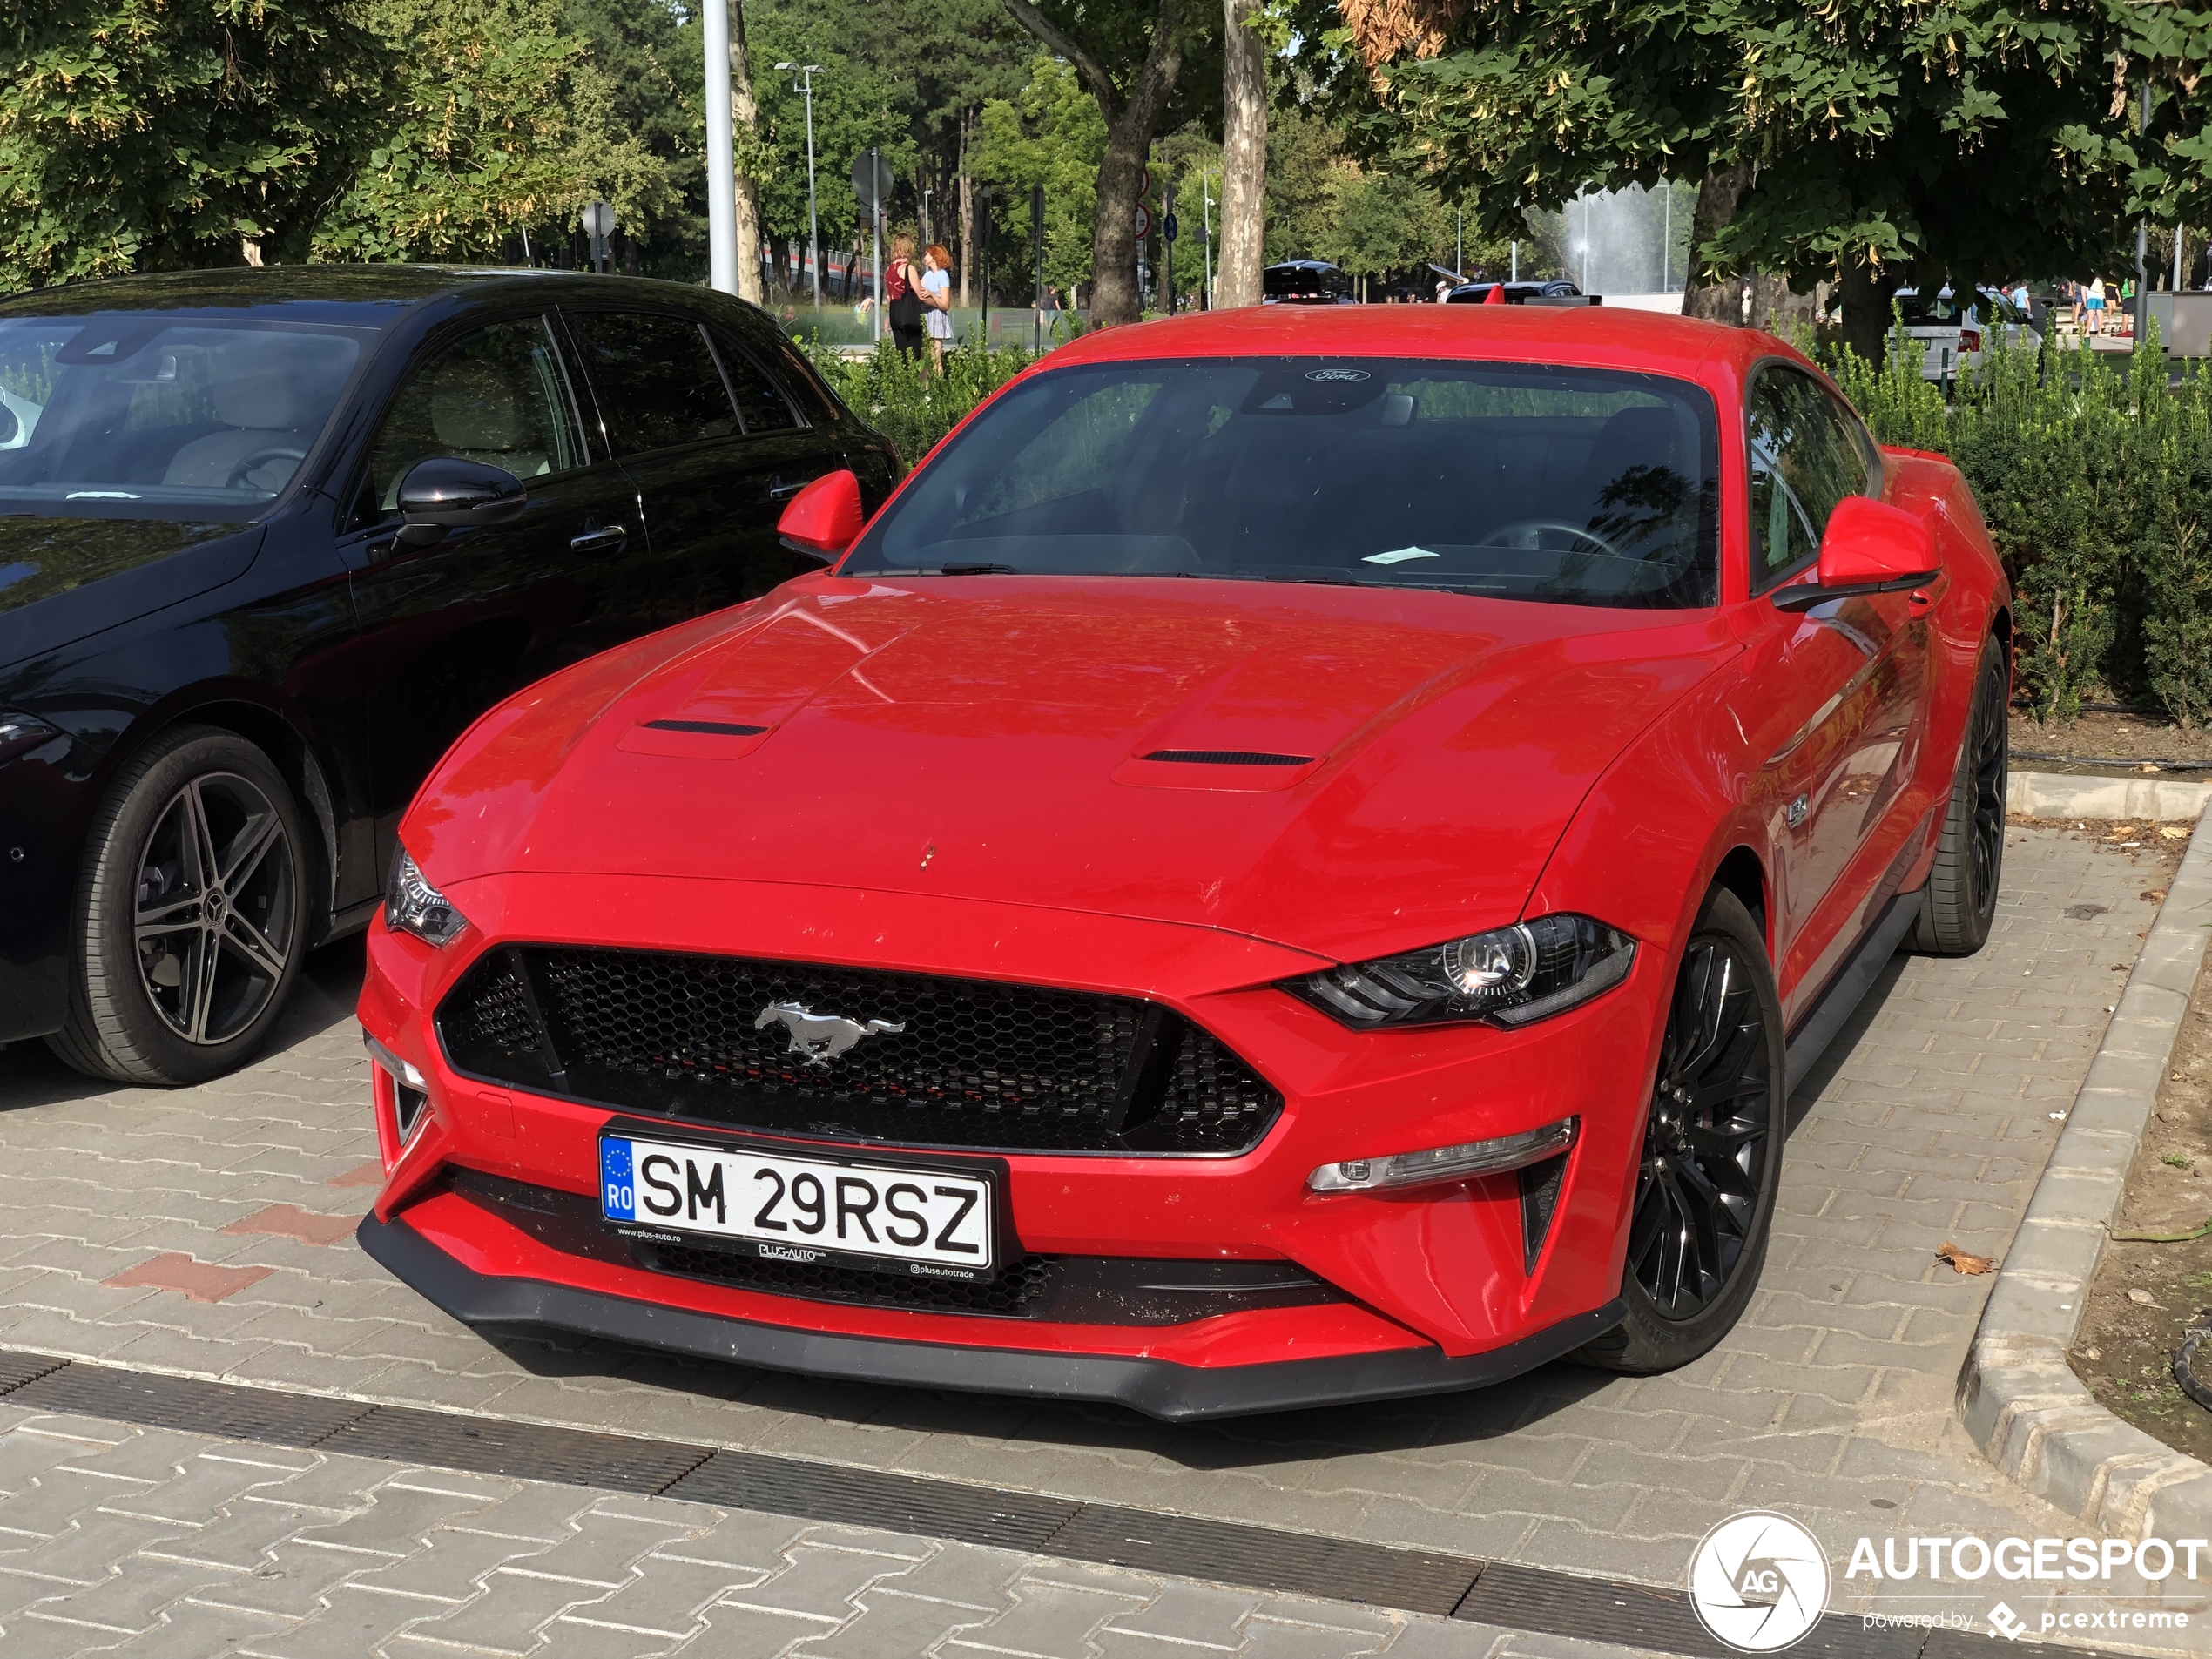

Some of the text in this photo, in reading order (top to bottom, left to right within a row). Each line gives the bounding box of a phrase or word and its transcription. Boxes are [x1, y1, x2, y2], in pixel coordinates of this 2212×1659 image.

[1315, 370, 1359, 380] Ford
[607, 1184, 632, 1211] RO
[641, 1155, 725, 1224] SM
[617, 1228, 681, 1243] www.plus-auto.ro
